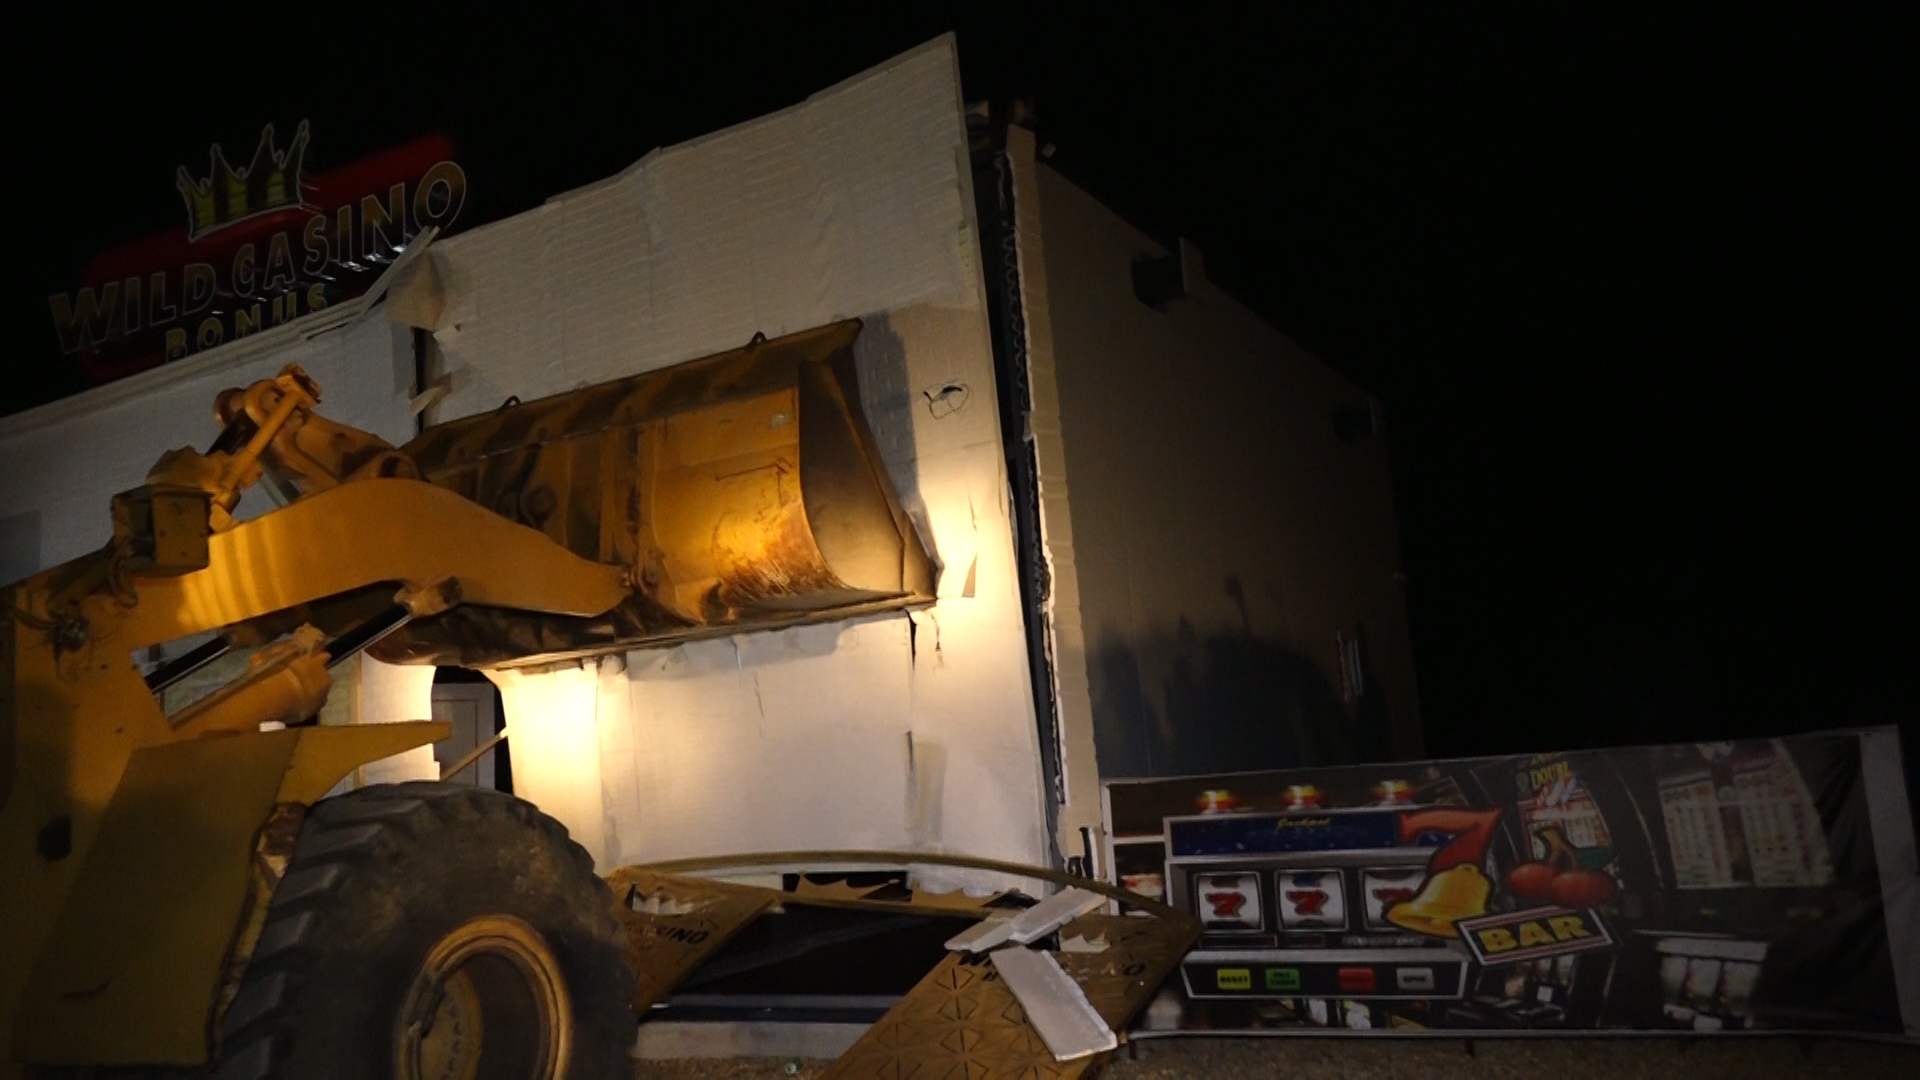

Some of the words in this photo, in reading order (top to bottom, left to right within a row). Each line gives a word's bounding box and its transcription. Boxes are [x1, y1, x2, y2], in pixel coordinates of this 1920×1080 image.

[49, 263, 217, 355] WILD
[232, 161, 467, 298] CASINO
[165, 283, 327, 363] BONUS
[1477, 914, 1593, 954] BAR
